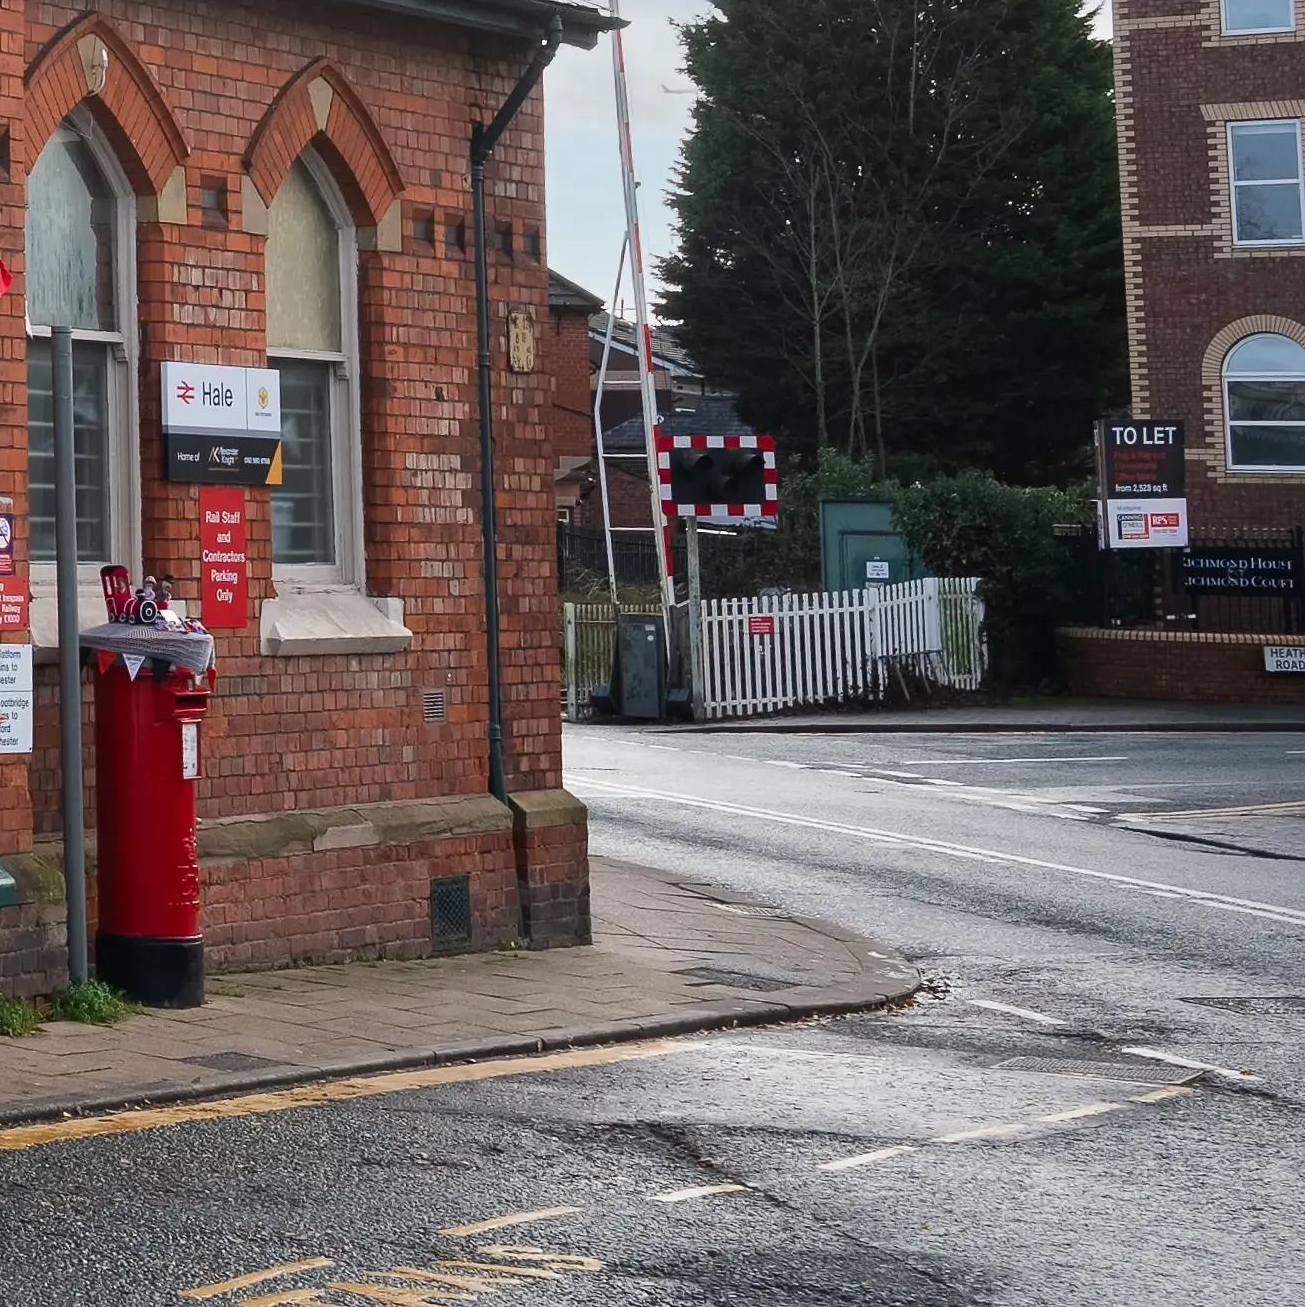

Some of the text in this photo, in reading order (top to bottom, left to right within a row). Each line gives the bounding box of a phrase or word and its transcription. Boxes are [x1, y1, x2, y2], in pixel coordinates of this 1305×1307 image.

[202, 381, 234, 407] Hale
[1111, 426, 1177, 445] TO LET
[177, 451, 194, 461] Home
[1115, 483, 1132, 492] from
[205, 510, 241, 524] Rail Staff
[216, 531, 231, 543] and
[202, 550, 245, 563] Contractors
[211, 569, 237, 584] Parking
[216, 588, 233, 603] Only
[1270, 648, 1305, 658] HEATH
[11, 662, 18, 672] to
[1276, 659, 1305, 671] ROAD
[11, 711, 18, 720] to
